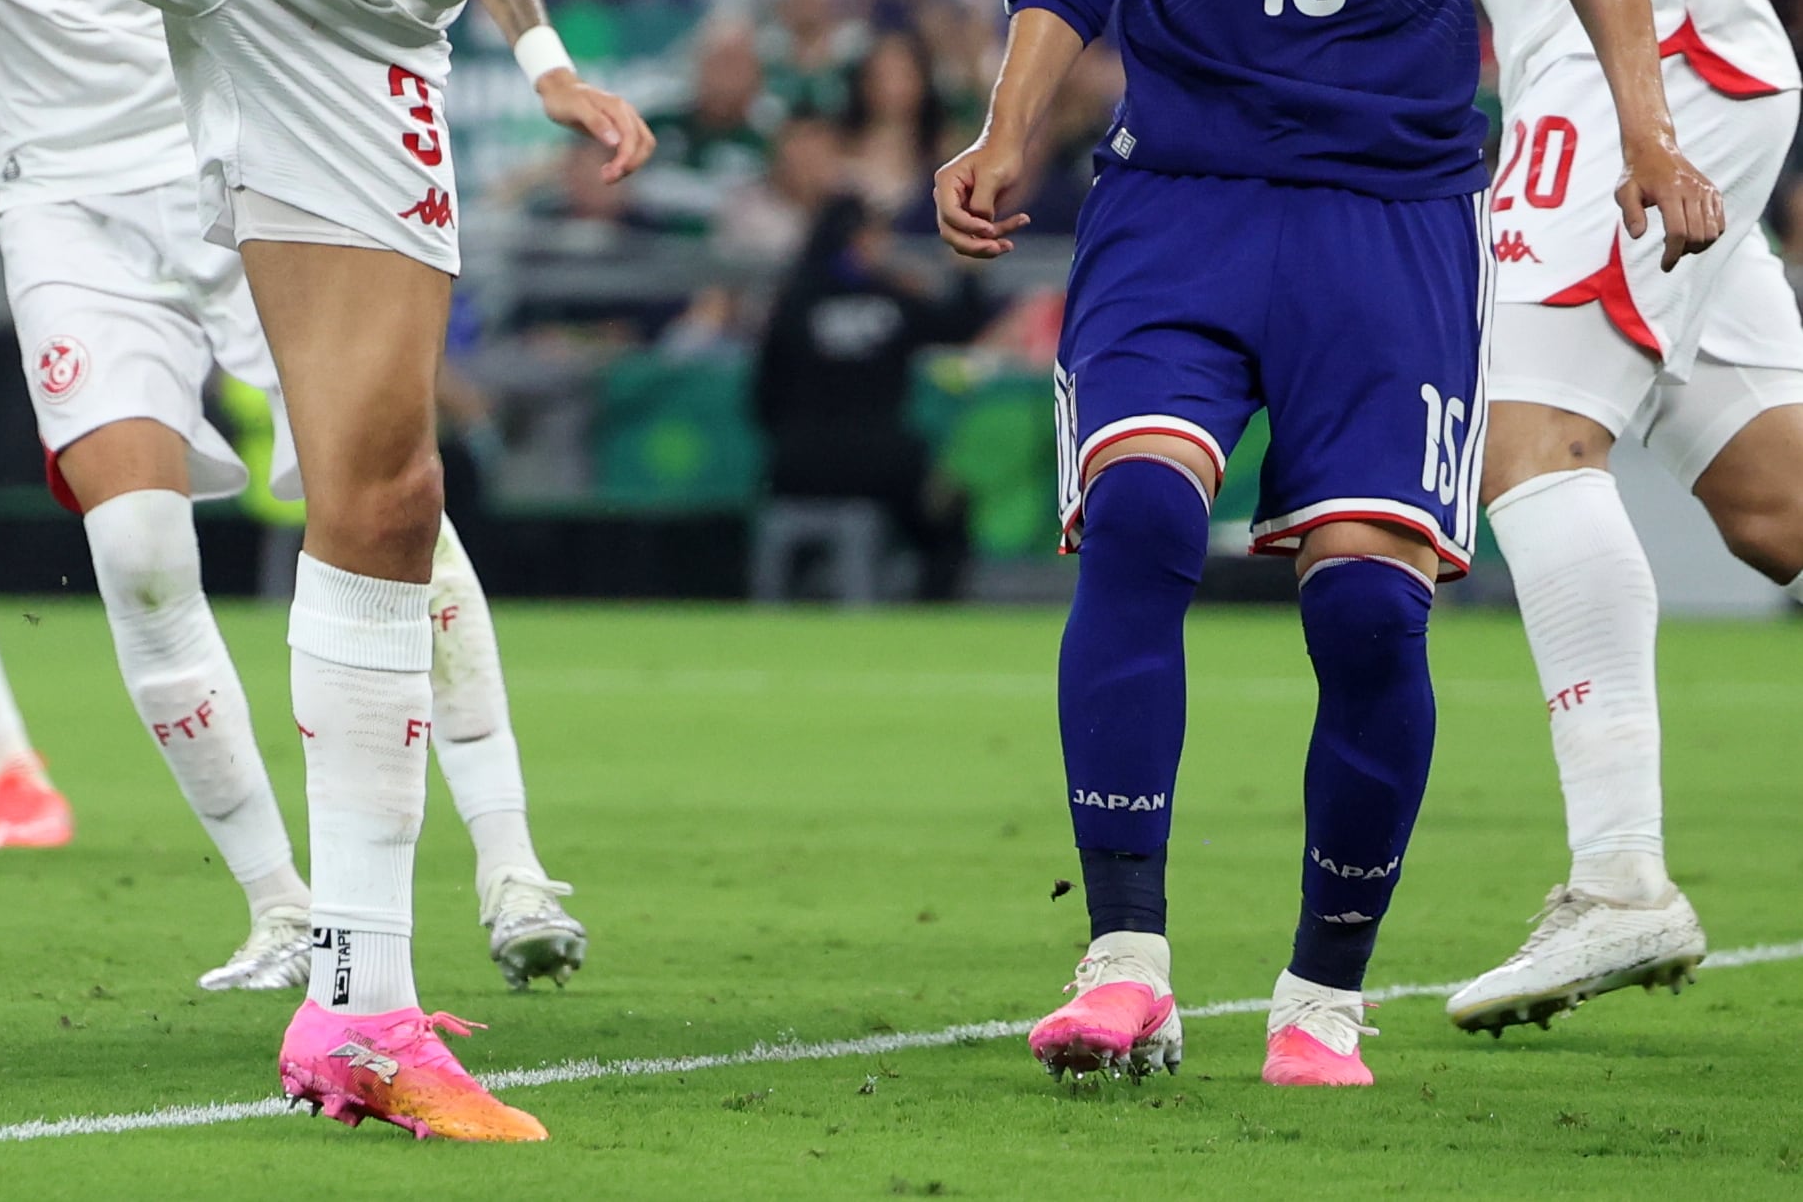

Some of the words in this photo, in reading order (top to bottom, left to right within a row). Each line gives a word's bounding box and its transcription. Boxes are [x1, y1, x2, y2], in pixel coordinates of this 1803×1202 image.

[1490, 115, 1578, 214] 20
[1421, 383, 1465, 506] 15
[152, 700, 213, 747] FTF
[1073, 789, 1166, 812] JAPAN
[1310, 846, 1399, 879] JAPAN
